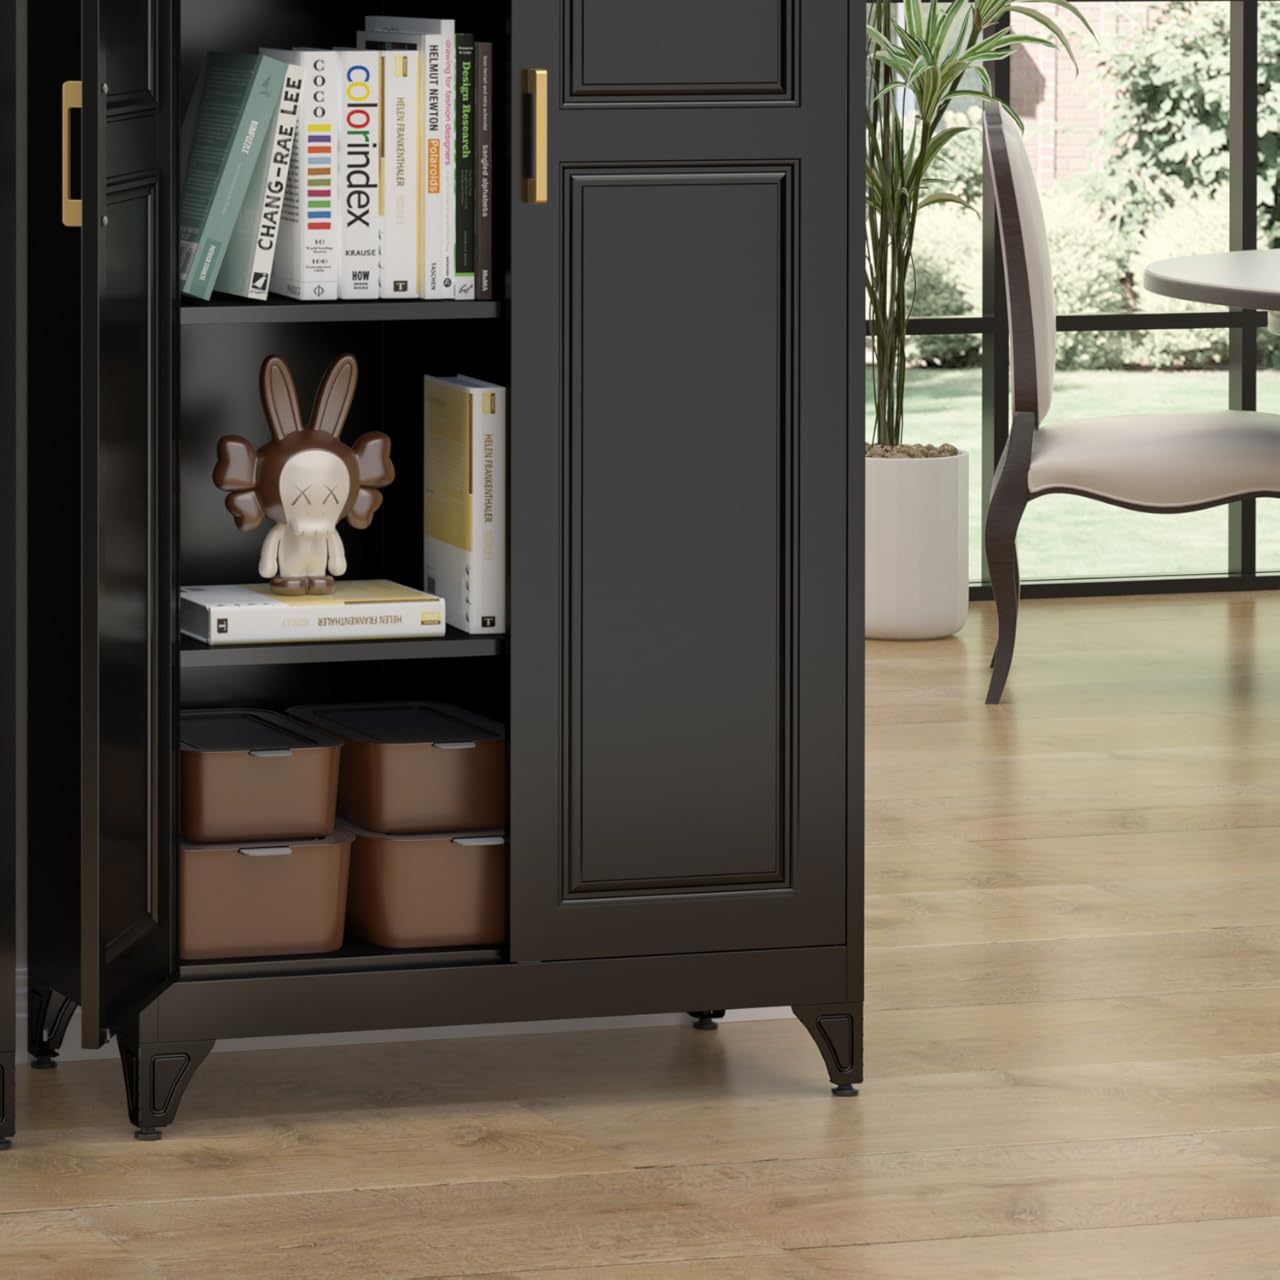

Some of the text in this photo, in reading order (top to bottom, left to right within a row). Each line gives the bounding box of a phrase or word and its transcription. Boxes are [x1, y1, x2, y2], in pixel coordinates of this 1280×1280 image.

[444, 39, 452, 74] drawing
[460, 61, 471, 102] Design
[396, 97, 405, 122] HELEN
[429, 44, 439, 193] HELMUT NEWTON Polaroids
[345, 64, 378, 227] colorindex
[444, 124, 452, 166] designers
[461, 104, 471, 158] Research
[258, 124, 294, 251] CHANG-RAE
[280, 77, 302, 116] LEE
[396, 123, 405, 187] FRANKENTHALER
[481, 177, 489, 218] alphabets
[345, 249, 376, 257] KRAUSE
[352, 270, 370, 281] HOW
[483, 433, 492, 459] HELEN
[483, 460, 493, 523] FRANKENTHALER
[317, 615, 377, 626] FRANKENTHALER
[379, 614, 402, 624] HELEN
